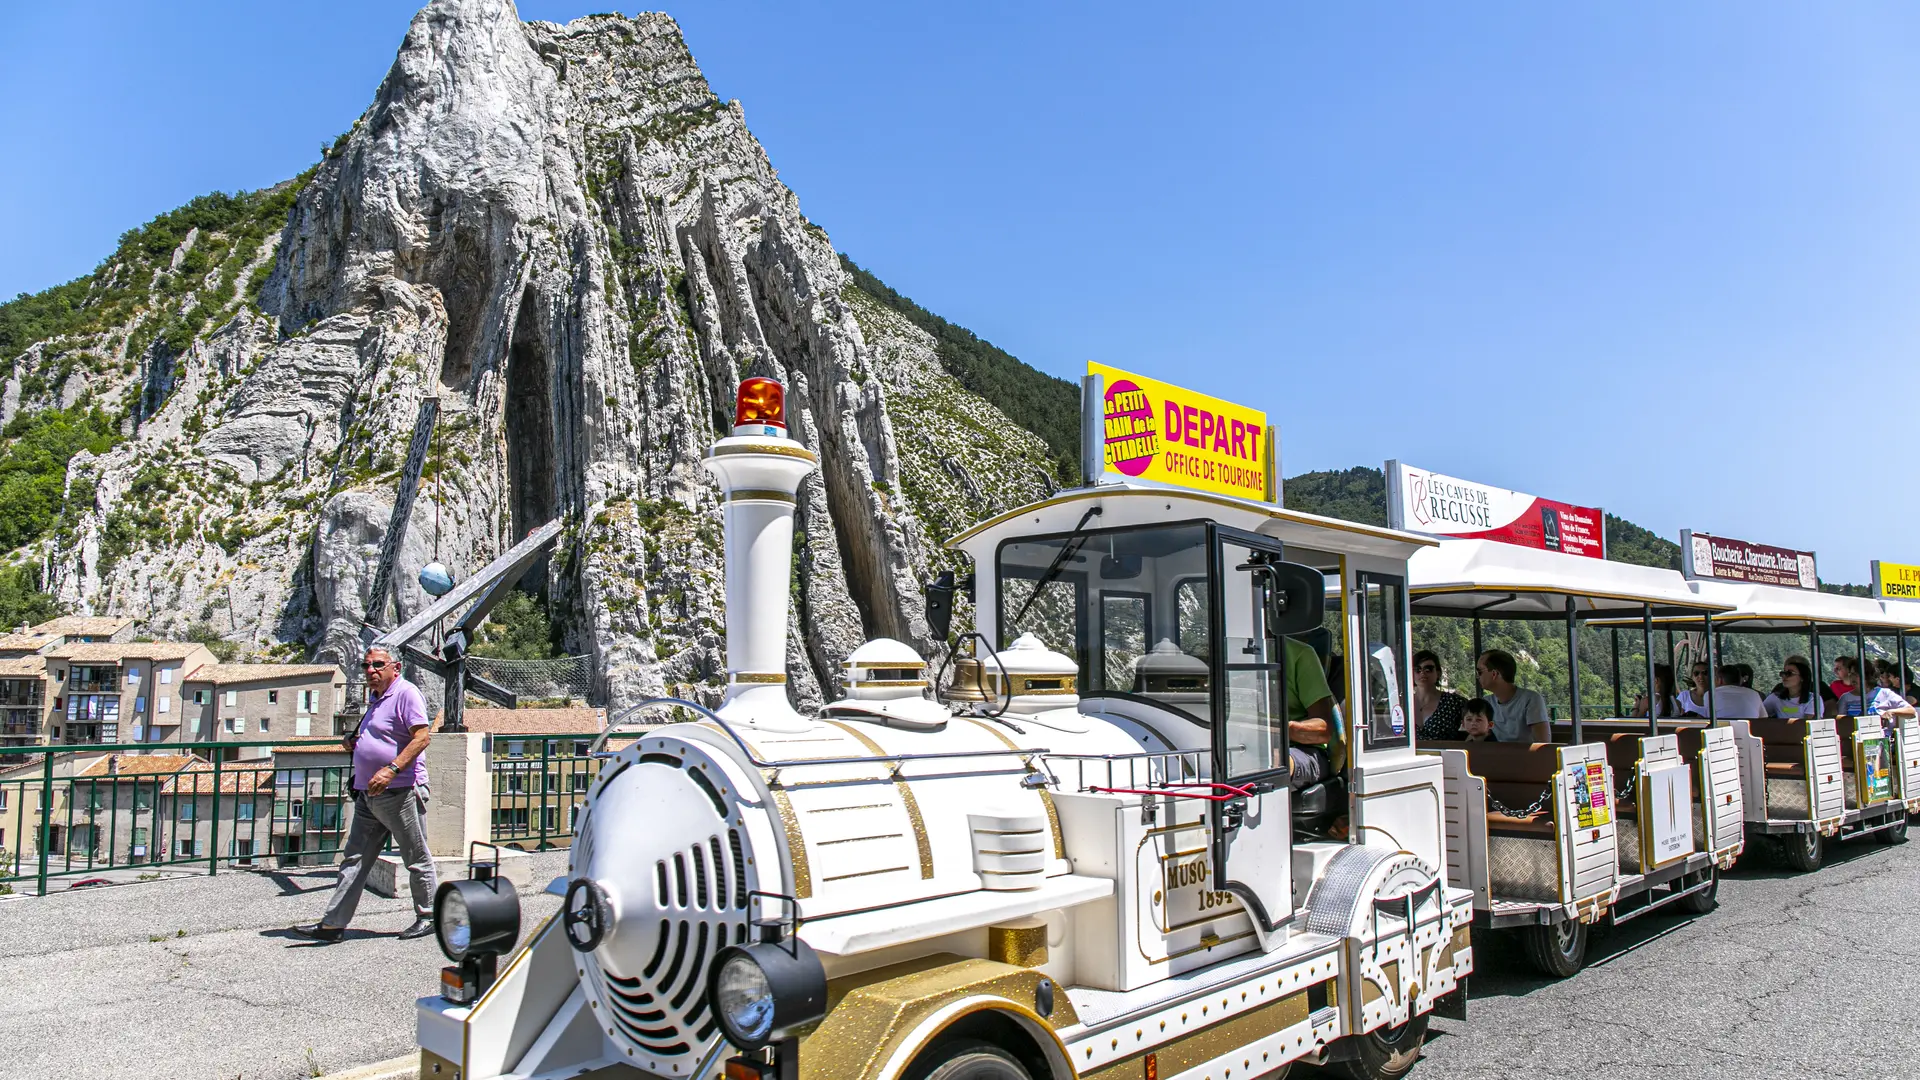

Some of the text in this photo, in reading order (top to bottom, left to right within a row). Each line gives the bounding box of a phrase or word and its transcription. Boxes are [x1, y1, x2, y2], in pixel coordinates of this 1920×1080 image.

[1114, 389, 1145, 413] PETIT
[1133, 417, 1146, 434] de
[1146, 416, 1156, 432] la
[1164, 400, 1261, 462] DEPART
[1104, 434, 1160, 465] CITADELLE
[1165, 451, 1263, 491] OFFICE DE TOURISME
[1428, 479, 1489, 505] LES CAVES DE
[1430, 496, 1492, 528] REGUSSE
[1777, 553, 1798, 572] Traiteur
[1899, 568, 1920, 582] LE P
[1886, 583, 1916, 597] DEPART
[1167, 860, 1207, 890] MUSO
[1197, 889, 1233, 911] 1894
